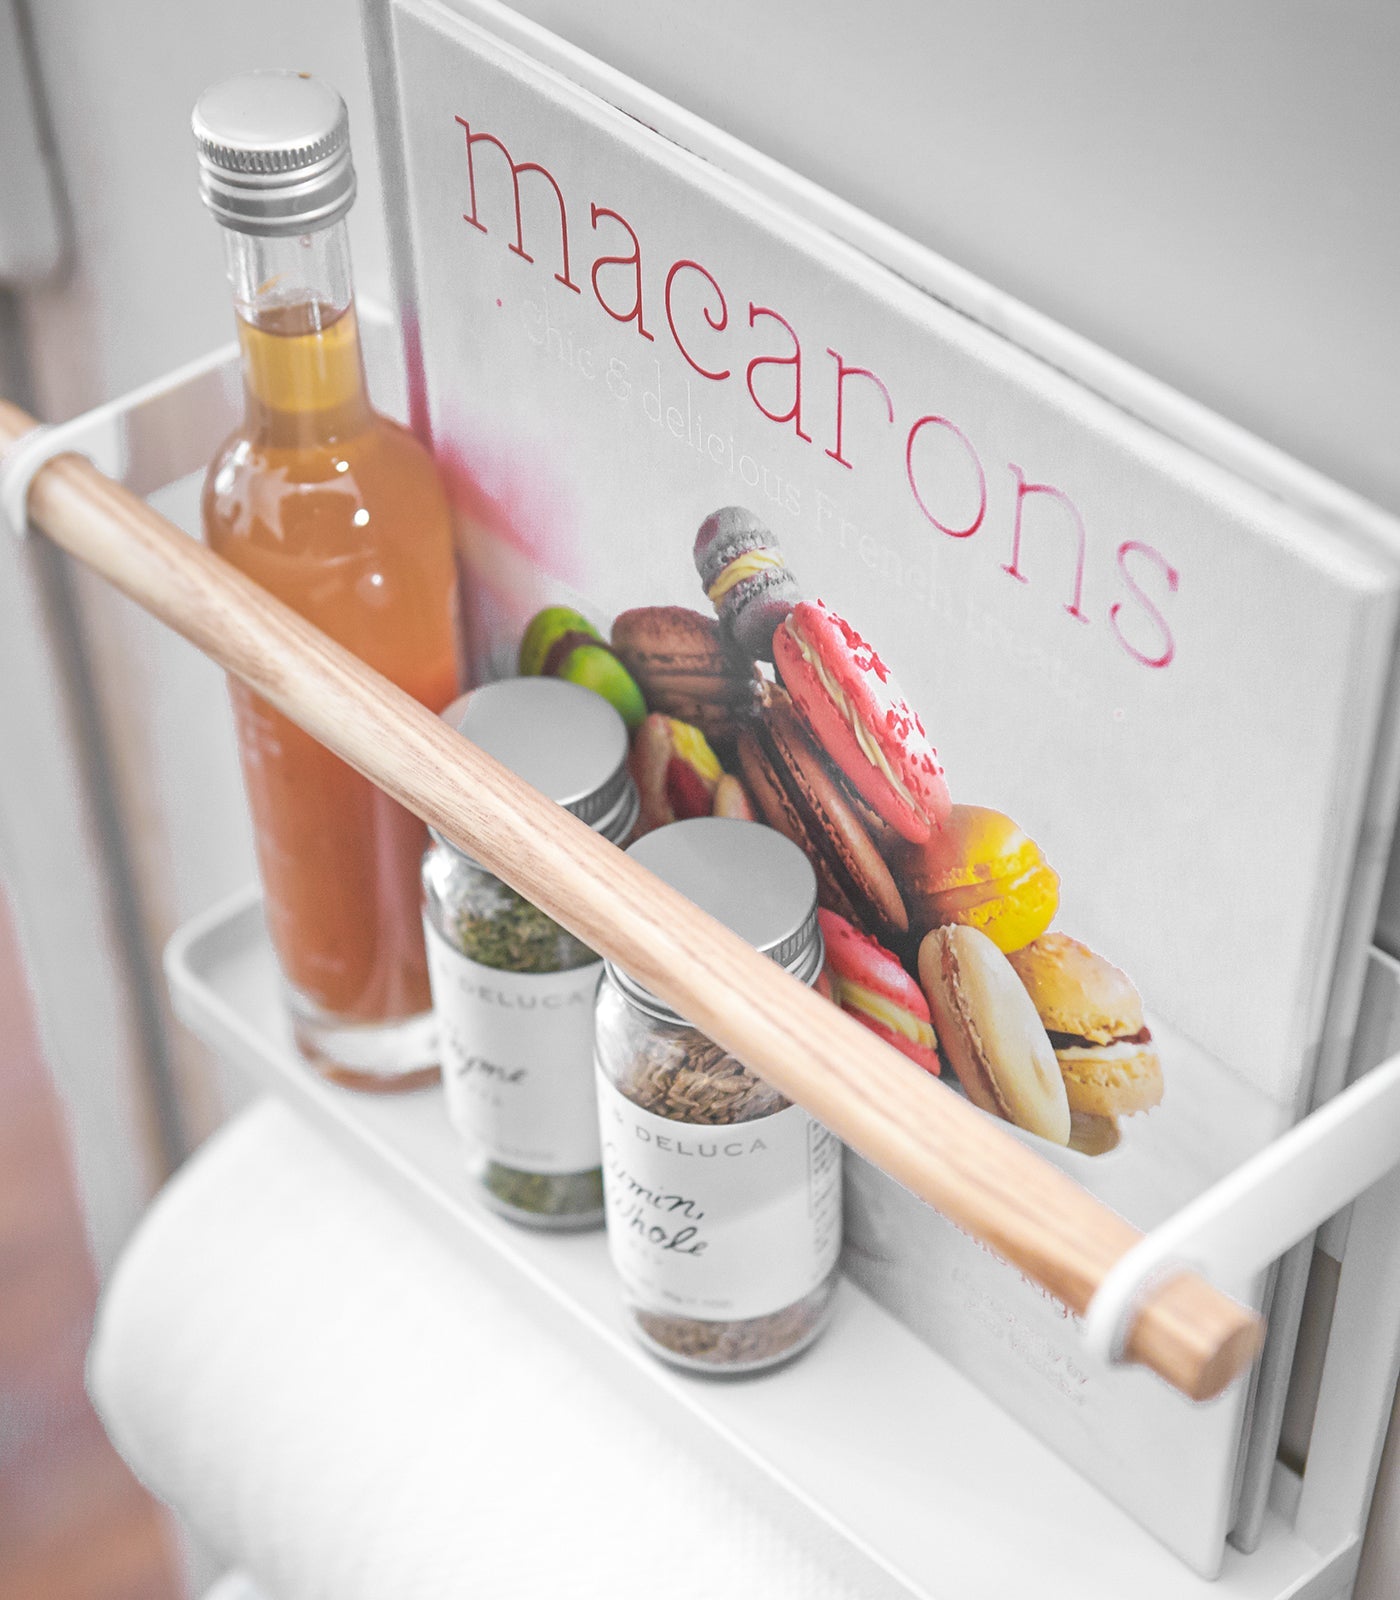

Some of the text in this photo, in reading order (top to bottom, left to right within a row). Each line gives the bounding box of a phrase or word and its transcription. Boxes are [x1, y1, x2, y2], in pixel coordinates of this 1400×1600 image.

[454, 115, 1180, 669] macarons
[642, 359, 801, 517] delicious
[635, 1124, 769, 1159] DELUCA
